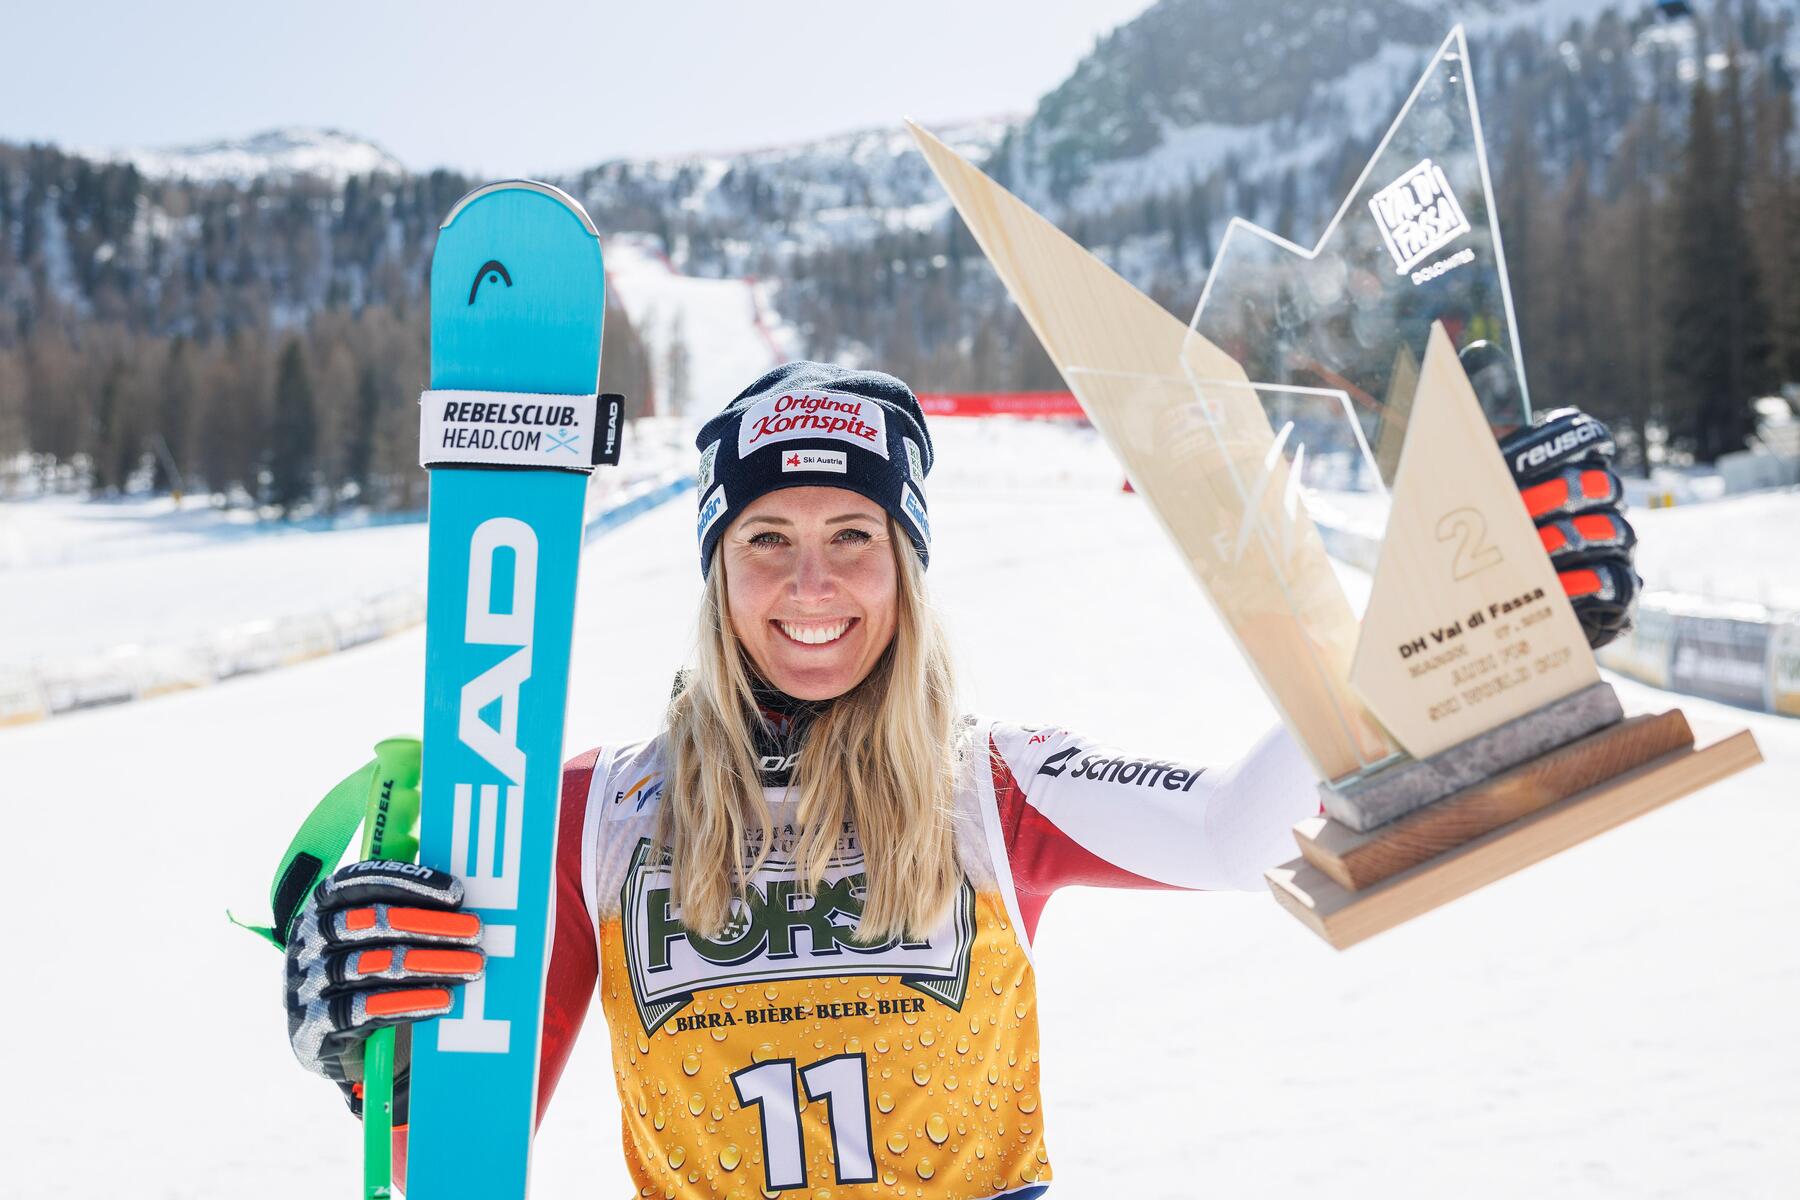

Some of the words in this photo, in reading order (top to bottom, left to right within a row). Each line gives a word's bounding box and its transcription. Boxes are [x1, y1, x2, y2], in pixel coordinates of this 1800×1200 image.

[443, 402, 579, 427] REBELSCLUB.
[774, 395, 862, 416] Original
[442, 428, 541, 452] HEAD.COM
[604, 402, 619, 454] HEAD
[749, 414, 879, 444] Kornspitz
[1515, 421, 1604, 473] reusch
[803, 456, 815, 464] Ski
[817, 457, 843, 466] Austria
[1435, 506, 1504, 582] 2
[1398, 636, 1428, 659] DH
[1431, 621, 1462, 644] Val
[1467, 610, 1485, 629] di
[1489, 587, 1546, 619] Fassa
[436, 516, 539, 1054] HEAD
[348, 860, 434, 880] reusch
[729, 1052, 878, 1192] 11
